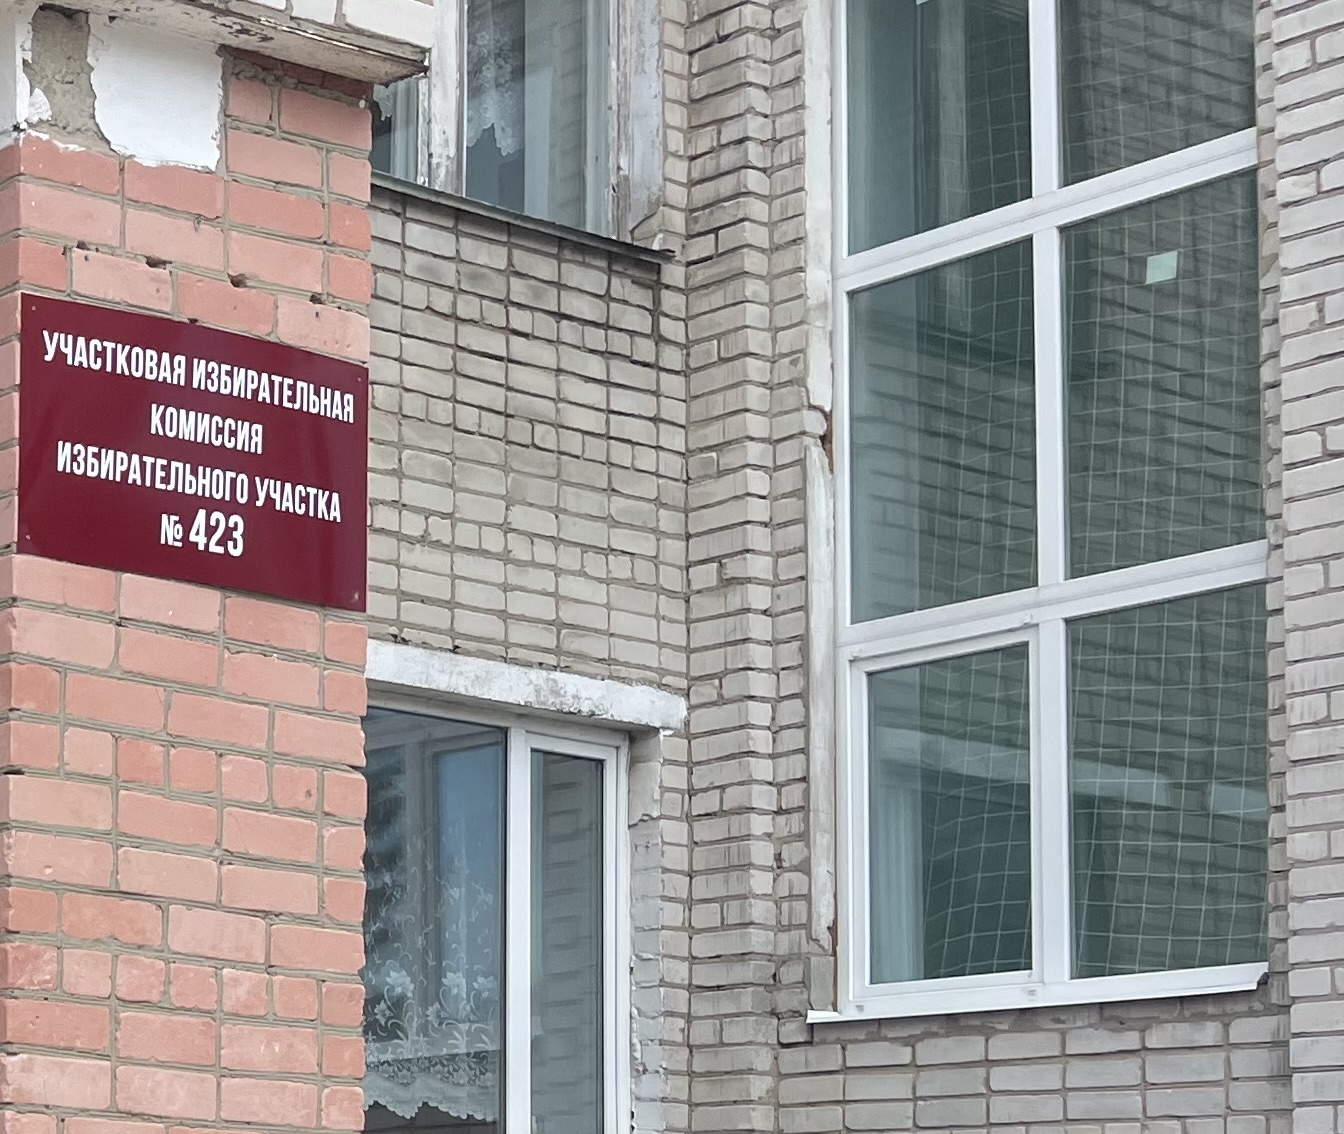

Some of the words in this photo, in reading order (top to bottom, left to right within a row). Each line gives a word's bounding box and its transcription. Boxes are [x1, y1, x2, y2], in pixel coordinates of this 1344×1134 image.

[43, 330, 186, 386] УЧАСТКОВАЯ
[192, 358, 354, 424] ИЗБИРАТЕЛЬНАЯ
[150, 403, 263, 455] КОМИССИЯ
[56, 440, 249, 504] ИЗБИРАТЕЛЬНОГО
[255, 476, 341, 523] УЧАСТКА
[160, 513, 183, 547] №
[189, 508, 245, 557] 423
